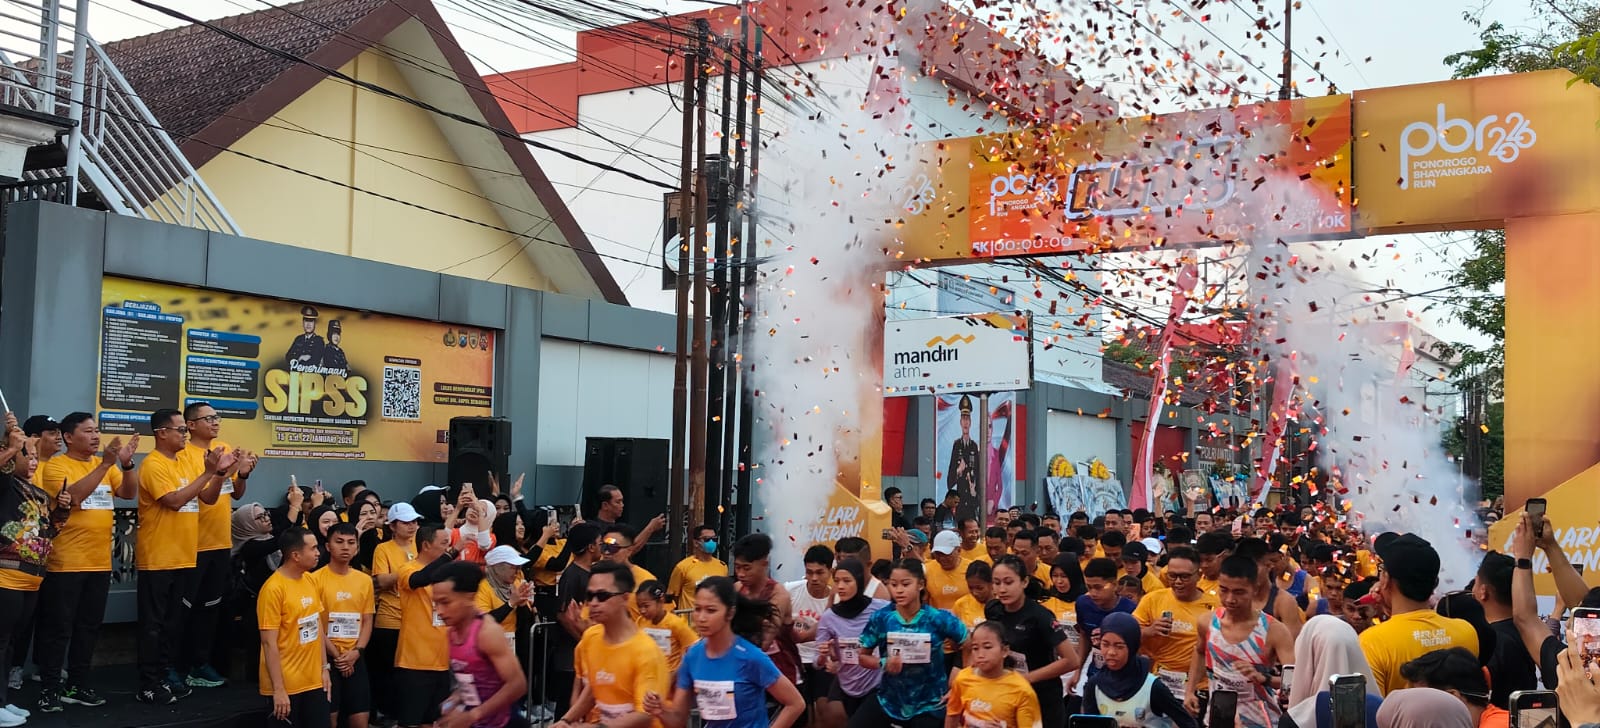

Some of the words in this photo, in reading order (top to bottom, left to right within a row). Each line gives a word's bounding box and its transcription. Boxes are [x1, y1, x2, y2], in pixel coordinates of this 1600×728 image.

[1400, 102, 1498, 190] pbr
[1413, 157, 1476, 169] PONOROGO
[1413, 165, 1492, 179] BHAYANGKARA
[1413, 179, 1436, 188] RUN
[972, 241, 989, 253] 5K
[894, 345, 958, 365] mandiri
[290, 359, 348, 378] Penerimaan
[894, 366, 921, 379] atm
[263, 368, 368, 418] SIPSS
[302, 434, 311, 442] 22
[312, 435, 337, 444] JANUARI
[827, 505, 860, 524] LARI
